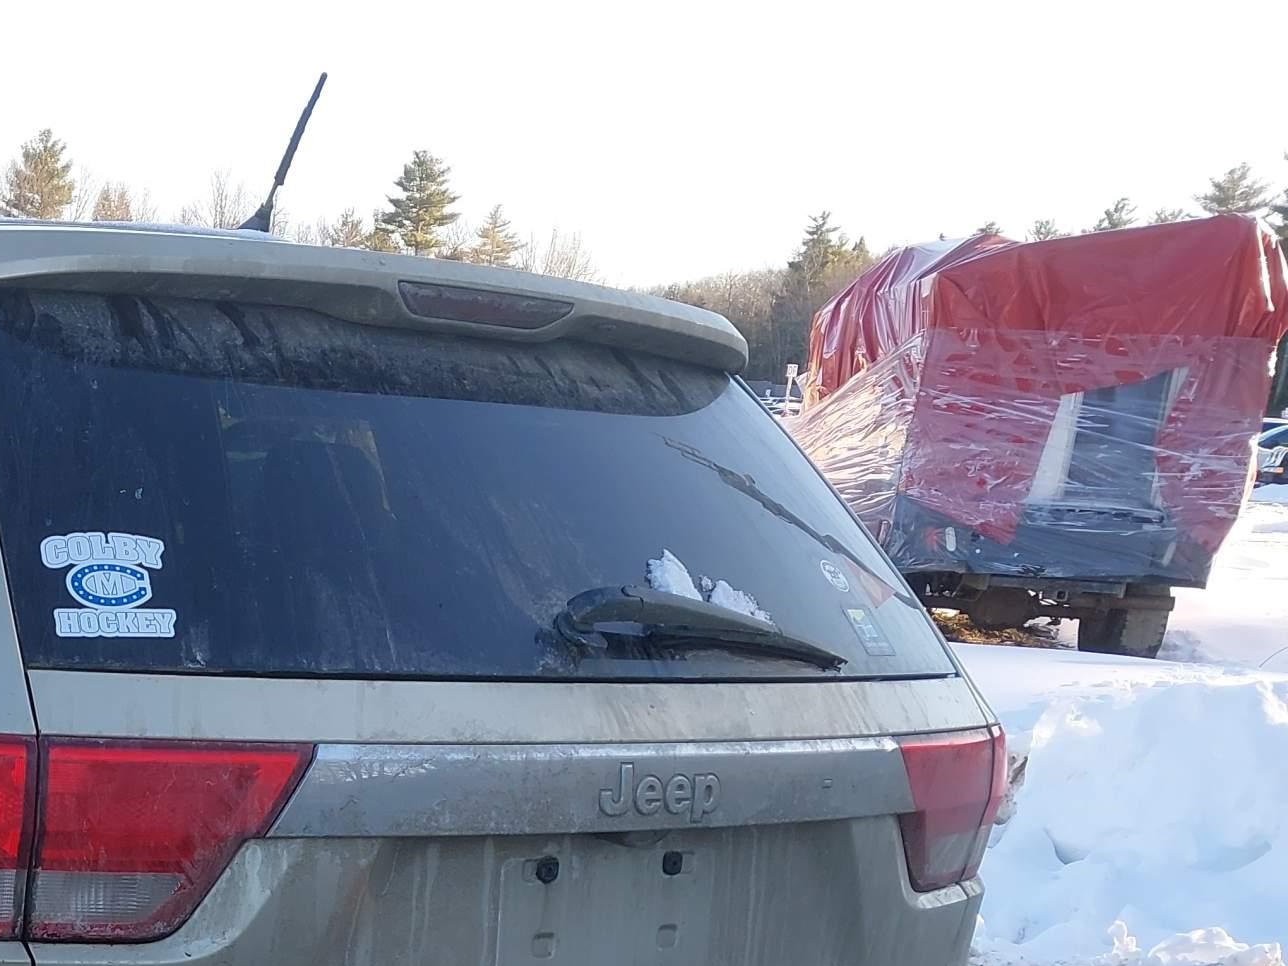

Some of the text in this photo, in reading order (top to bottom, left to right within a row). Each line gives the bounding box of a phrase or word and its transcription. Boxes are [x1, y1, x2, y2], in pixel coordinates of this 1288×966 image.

[43, 533, 163, 568] COLBY
[56, 610, 174, 635] HOCKEY
[599, 762, 721, 823] Jeep
